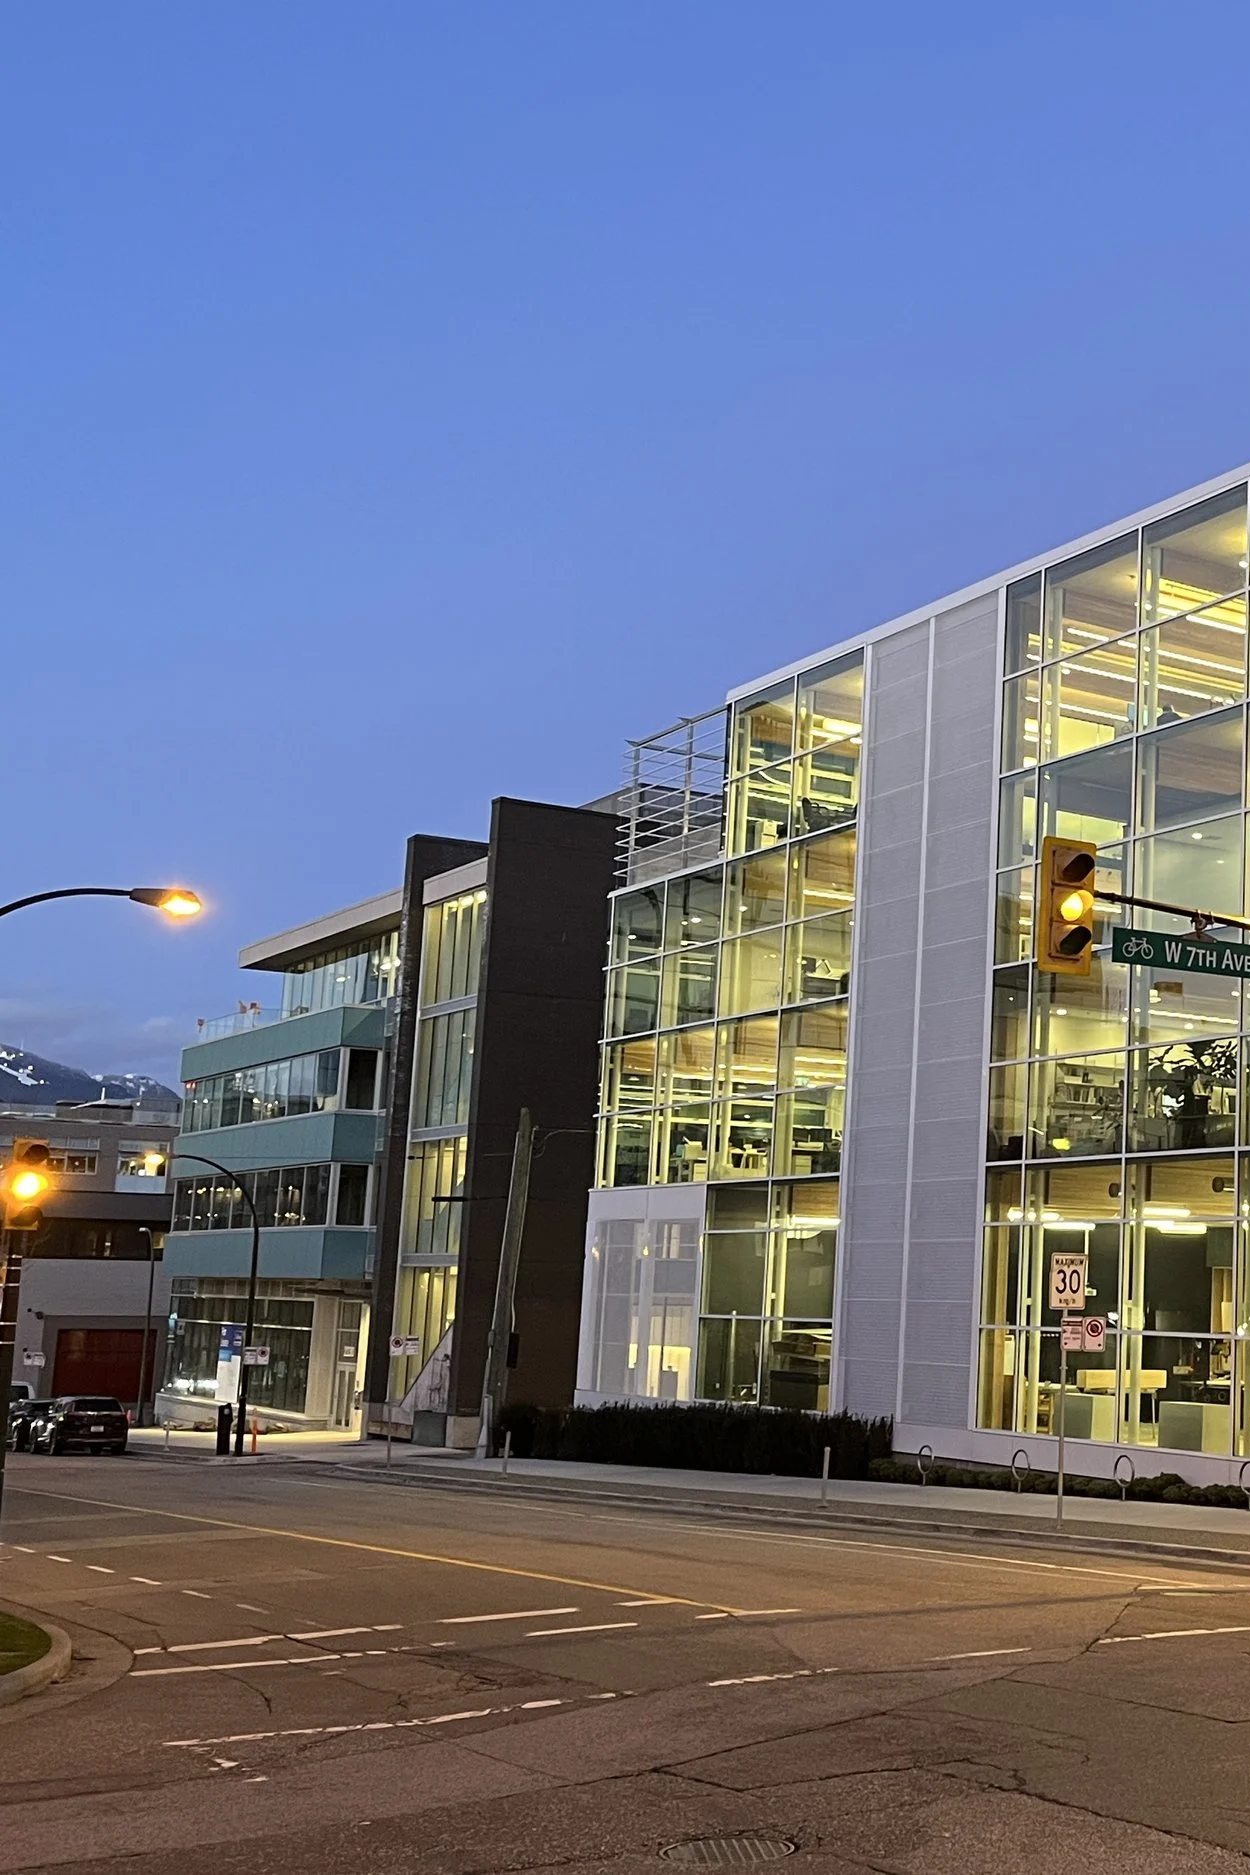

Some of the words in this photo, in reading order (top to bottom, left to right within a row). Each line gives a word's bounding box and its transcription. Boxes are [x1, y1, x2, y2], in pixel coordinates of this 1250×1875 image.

[1164, 940, 1182, 964] W
[1186, 946, 1217, 969] 7TH
[1055, 1257, 1085, 1266] MAXIMUM
[1055, 1269, 1081, 1294] 30
